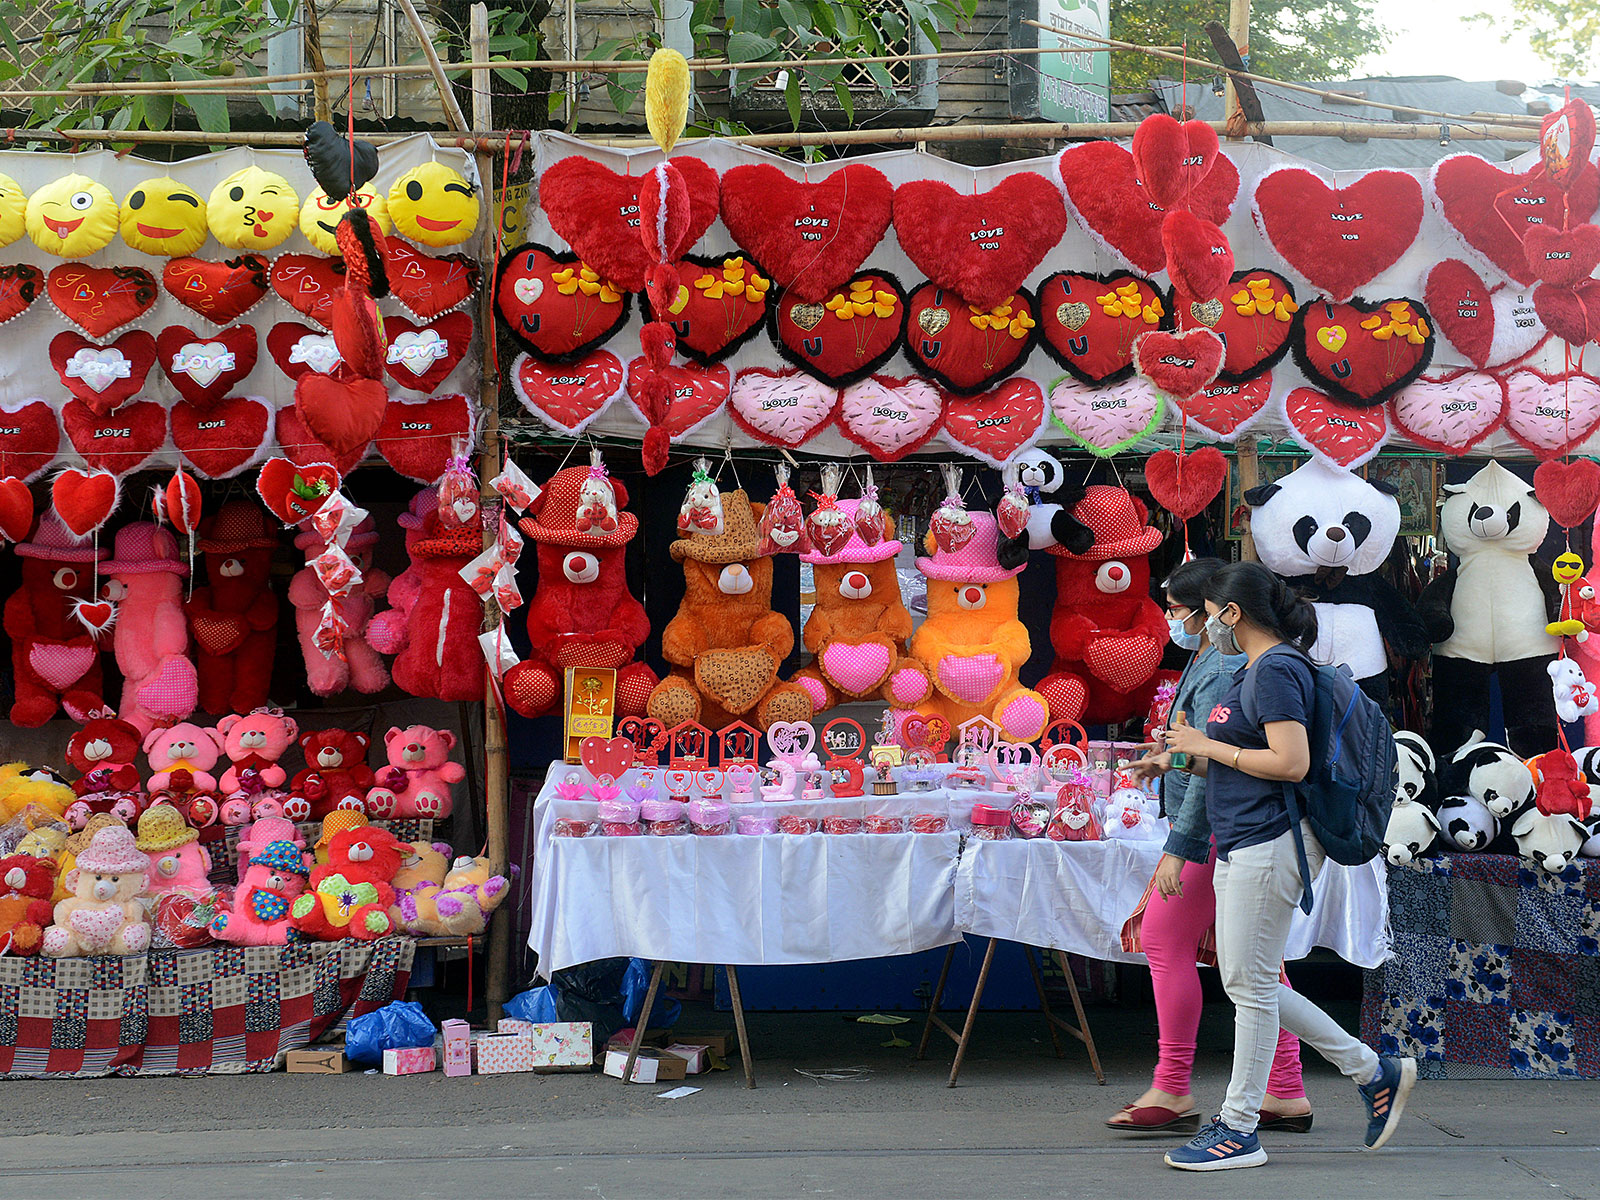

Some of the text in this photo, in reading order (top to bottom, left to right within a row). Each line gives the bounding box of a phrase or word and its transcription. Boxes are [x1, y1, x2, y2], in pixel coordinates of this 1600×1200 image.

[1513, 196, 1547, 205] LOVE
[620, 205, 640, 216] LO
[810, 204, 815, 212] I
[502, 206, 518, 233] C
[627, 218, 640, 227] YO
[794, 216, 829, 228] LOVE
[1331, 212, 1364, 222] LOVE
[1527, 215, 1543, 224] YOU
[801, 231, 822, 241] YOU
[969, 227, 1004, 241] LOVE
[1341, 233, 1359, 241] YOU
[979, 242, 1000, 250] YOU
[1545, 251, 1571, 259] LOVE
[526, 253, 535, 271] I
[1062, 280, 1072, 295] I
[1466, 290, 1471, 298] I
[1518, 295, 1524, 303] I
[1458, 309, 1478, 318] YOU
[521, 314, 540, 332] U
[1515, 318, 1536, 328] YOU
[804, 337, 822, 356] U
[923, 341, 941, 358] U
[1069, 336, 1088, 355] U
[171, 353, 235, 373] LOVE
[1331, 359, 1351, 378] U
[675, 387, 693, 398] VE
[1206, 384, 1240, 398] LOVE
[763, 396, 798, 410] LOVE
[1091, 398, 1127, 410] LOVE
[1441, 400, 1477, 414] LOVE
[873, 406, 908, 420] LOVE
[1535, 405, 1571, 419] LOVE
[198, 419, 226, 429] LOVE
[402, 422, 432, 430] LOVE
[976, 414, 1010, 429] LOVE
[1327, 416, 1360, 428] LOVE
[0, 427, 21, 435] OVE
[93, 427, 131, 438] LOVE
[290, 501, 308, 516] LOVE
